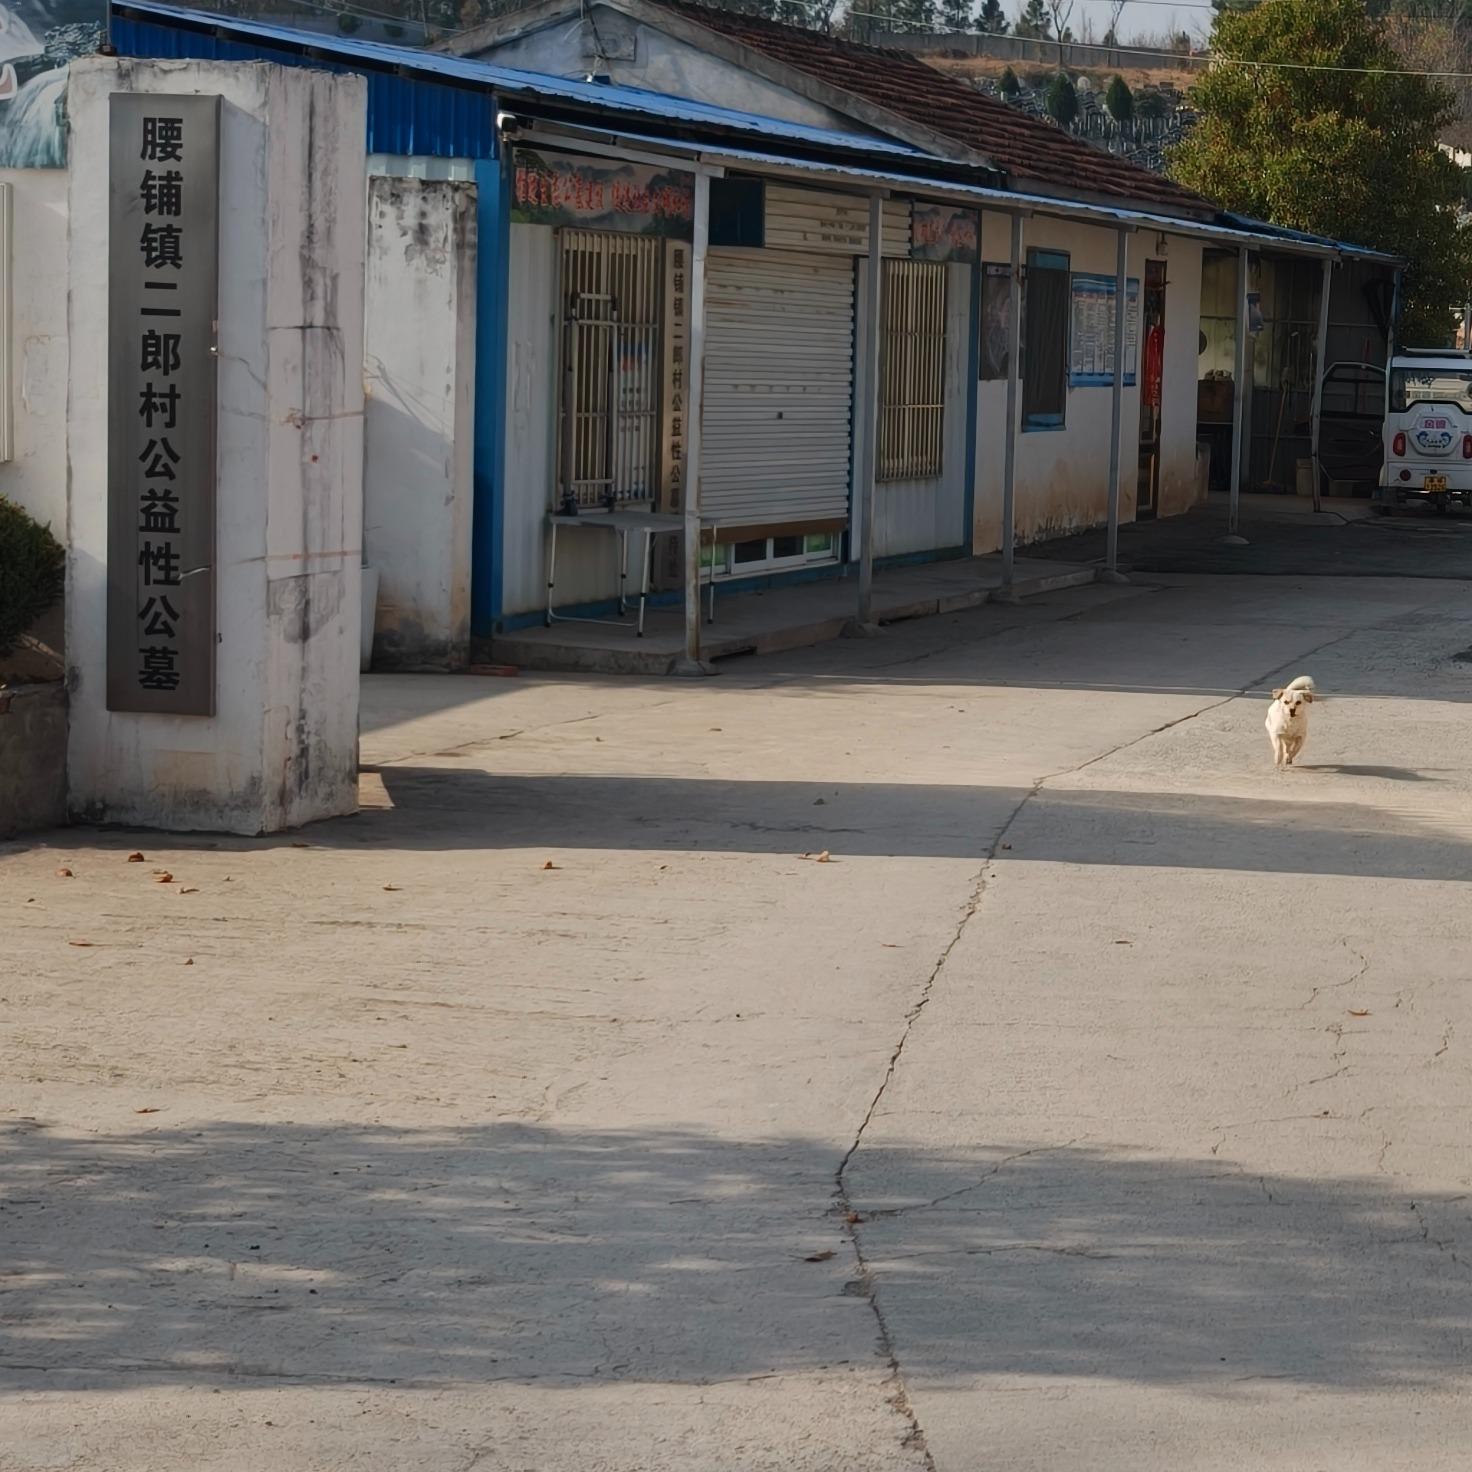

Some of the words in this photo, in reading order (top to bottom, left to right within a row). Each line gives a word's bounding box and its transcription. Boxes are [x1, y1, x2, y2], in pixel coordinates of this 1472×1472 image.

[138, 116, 184, 692] 腰铺镇二郎村公益性公墓
